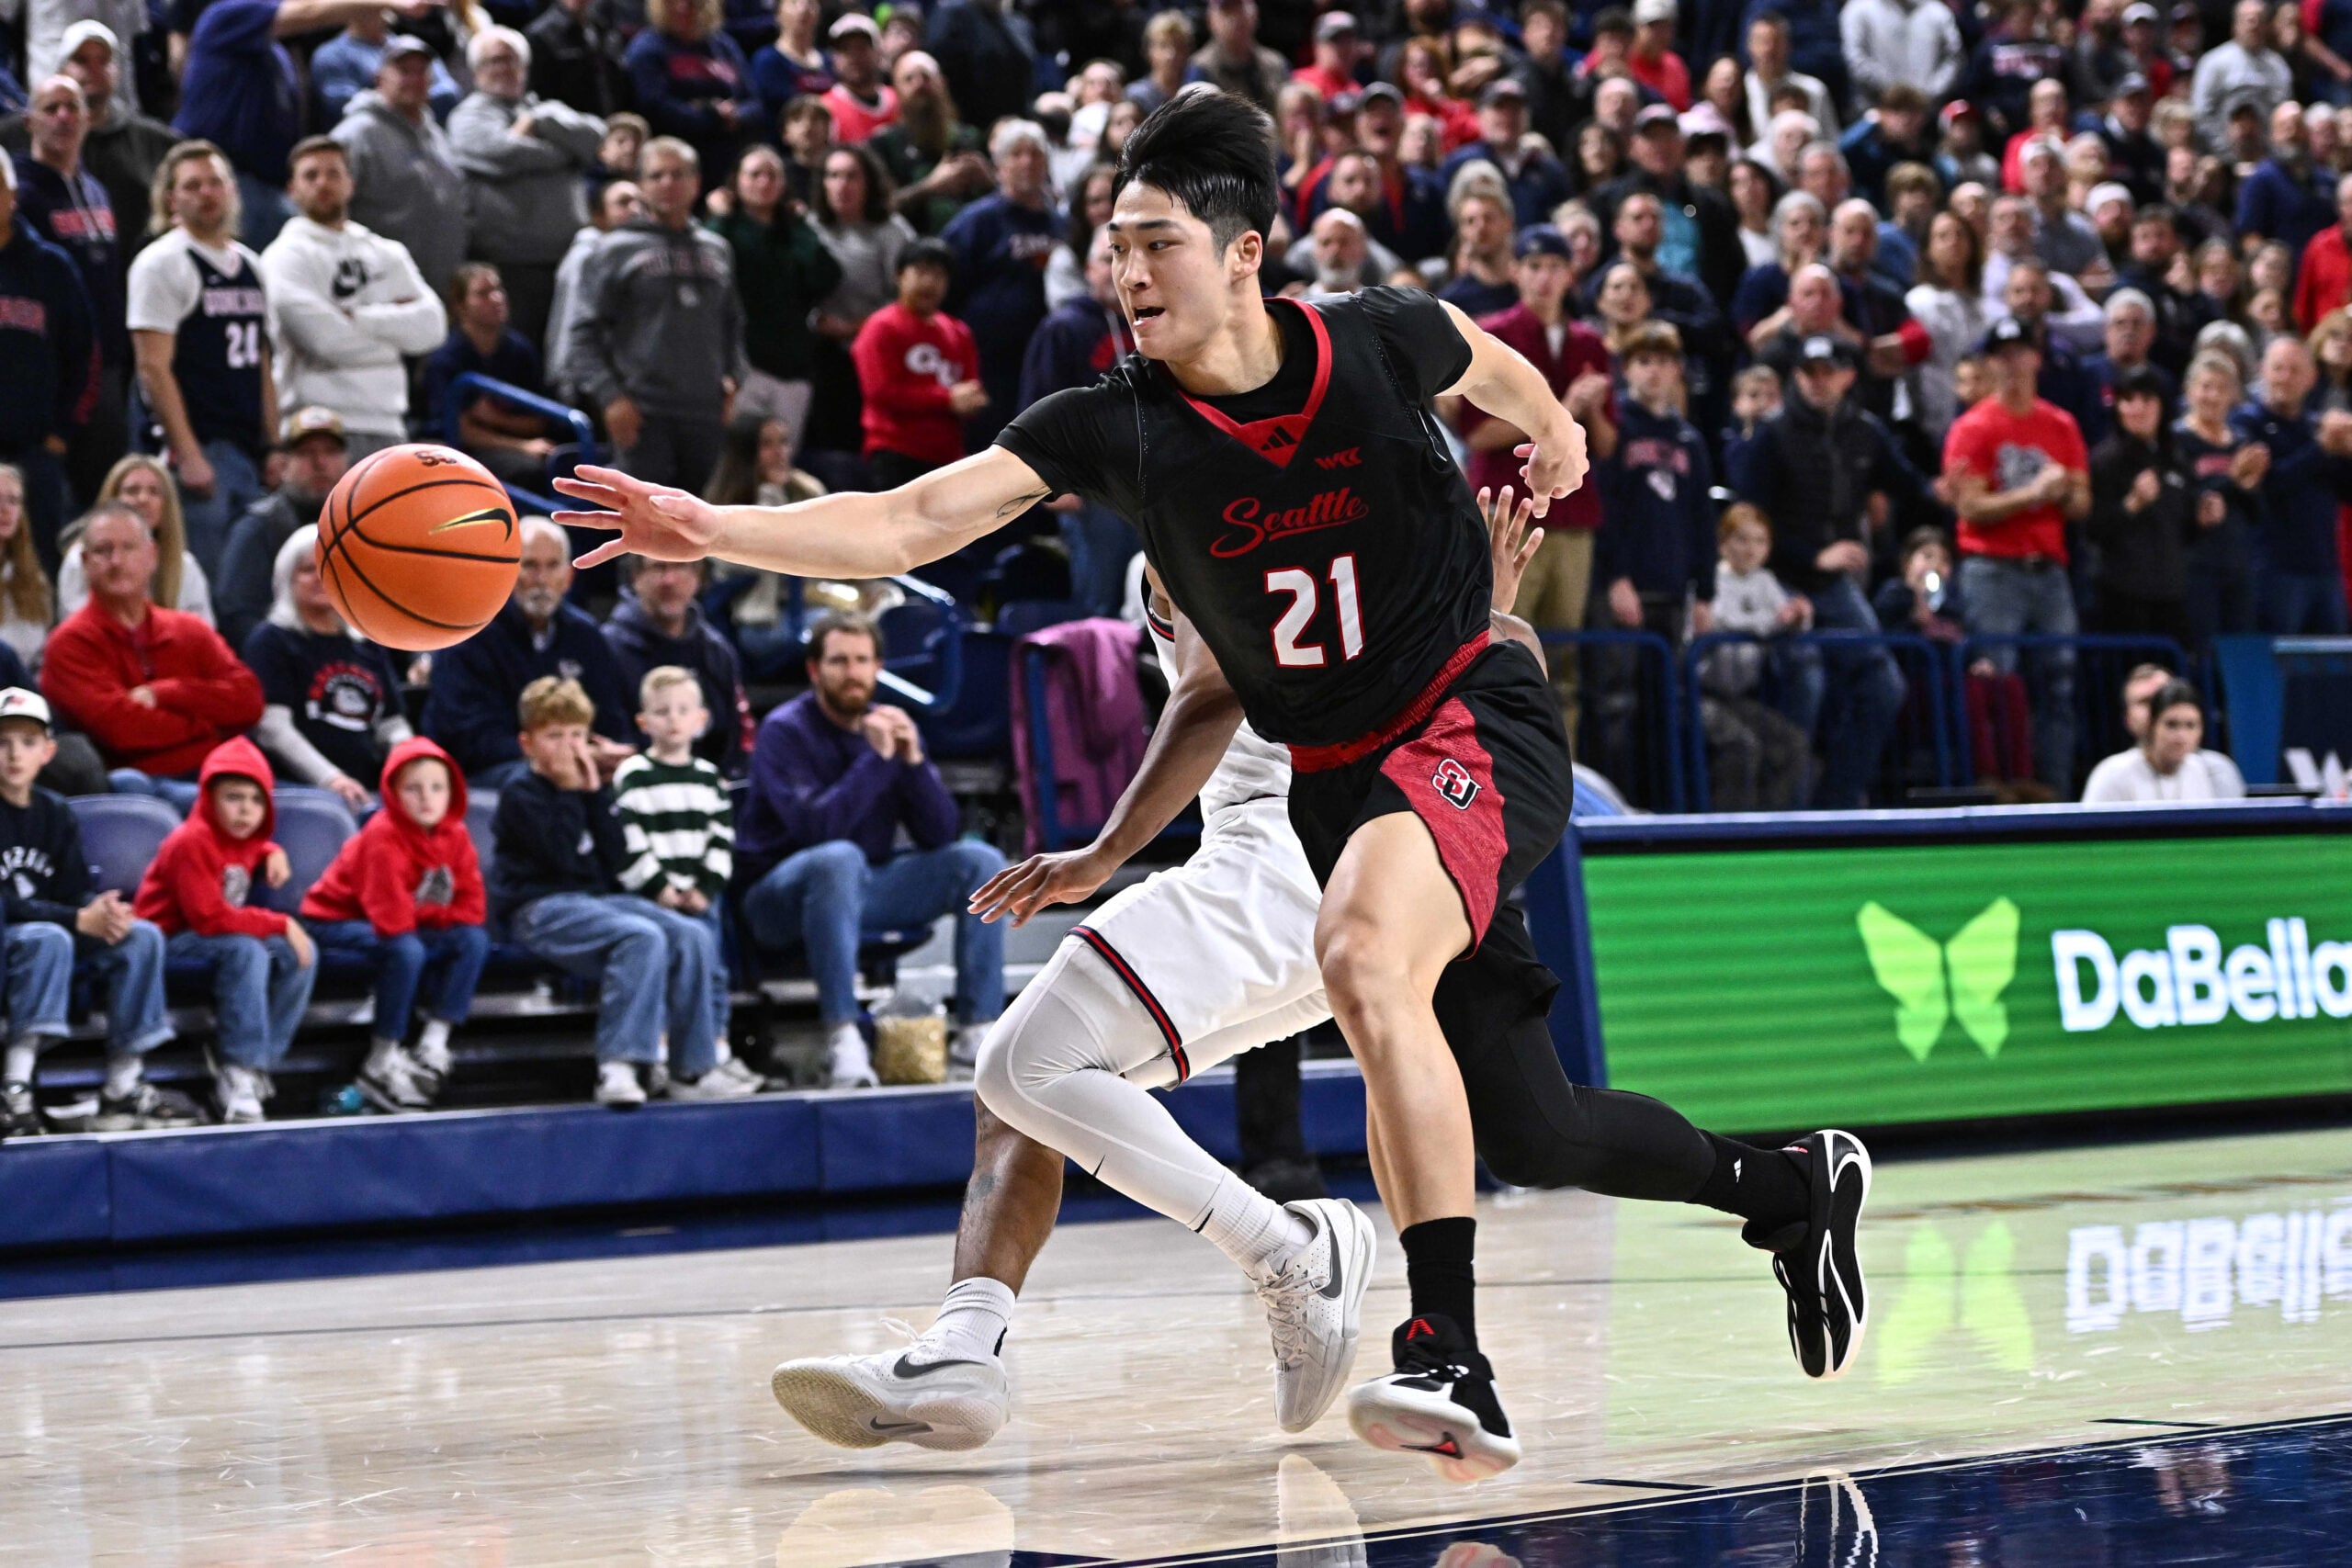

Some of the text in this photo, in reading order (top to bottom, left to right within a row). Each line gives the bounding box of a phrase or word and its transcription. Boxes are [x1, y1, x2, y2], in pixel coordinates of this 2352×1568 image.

[1209, 487, 1369, 558] Seattle
[1263, 552, 1366, 668] 21
[2051, 916, 2352, 1032] DaBella
